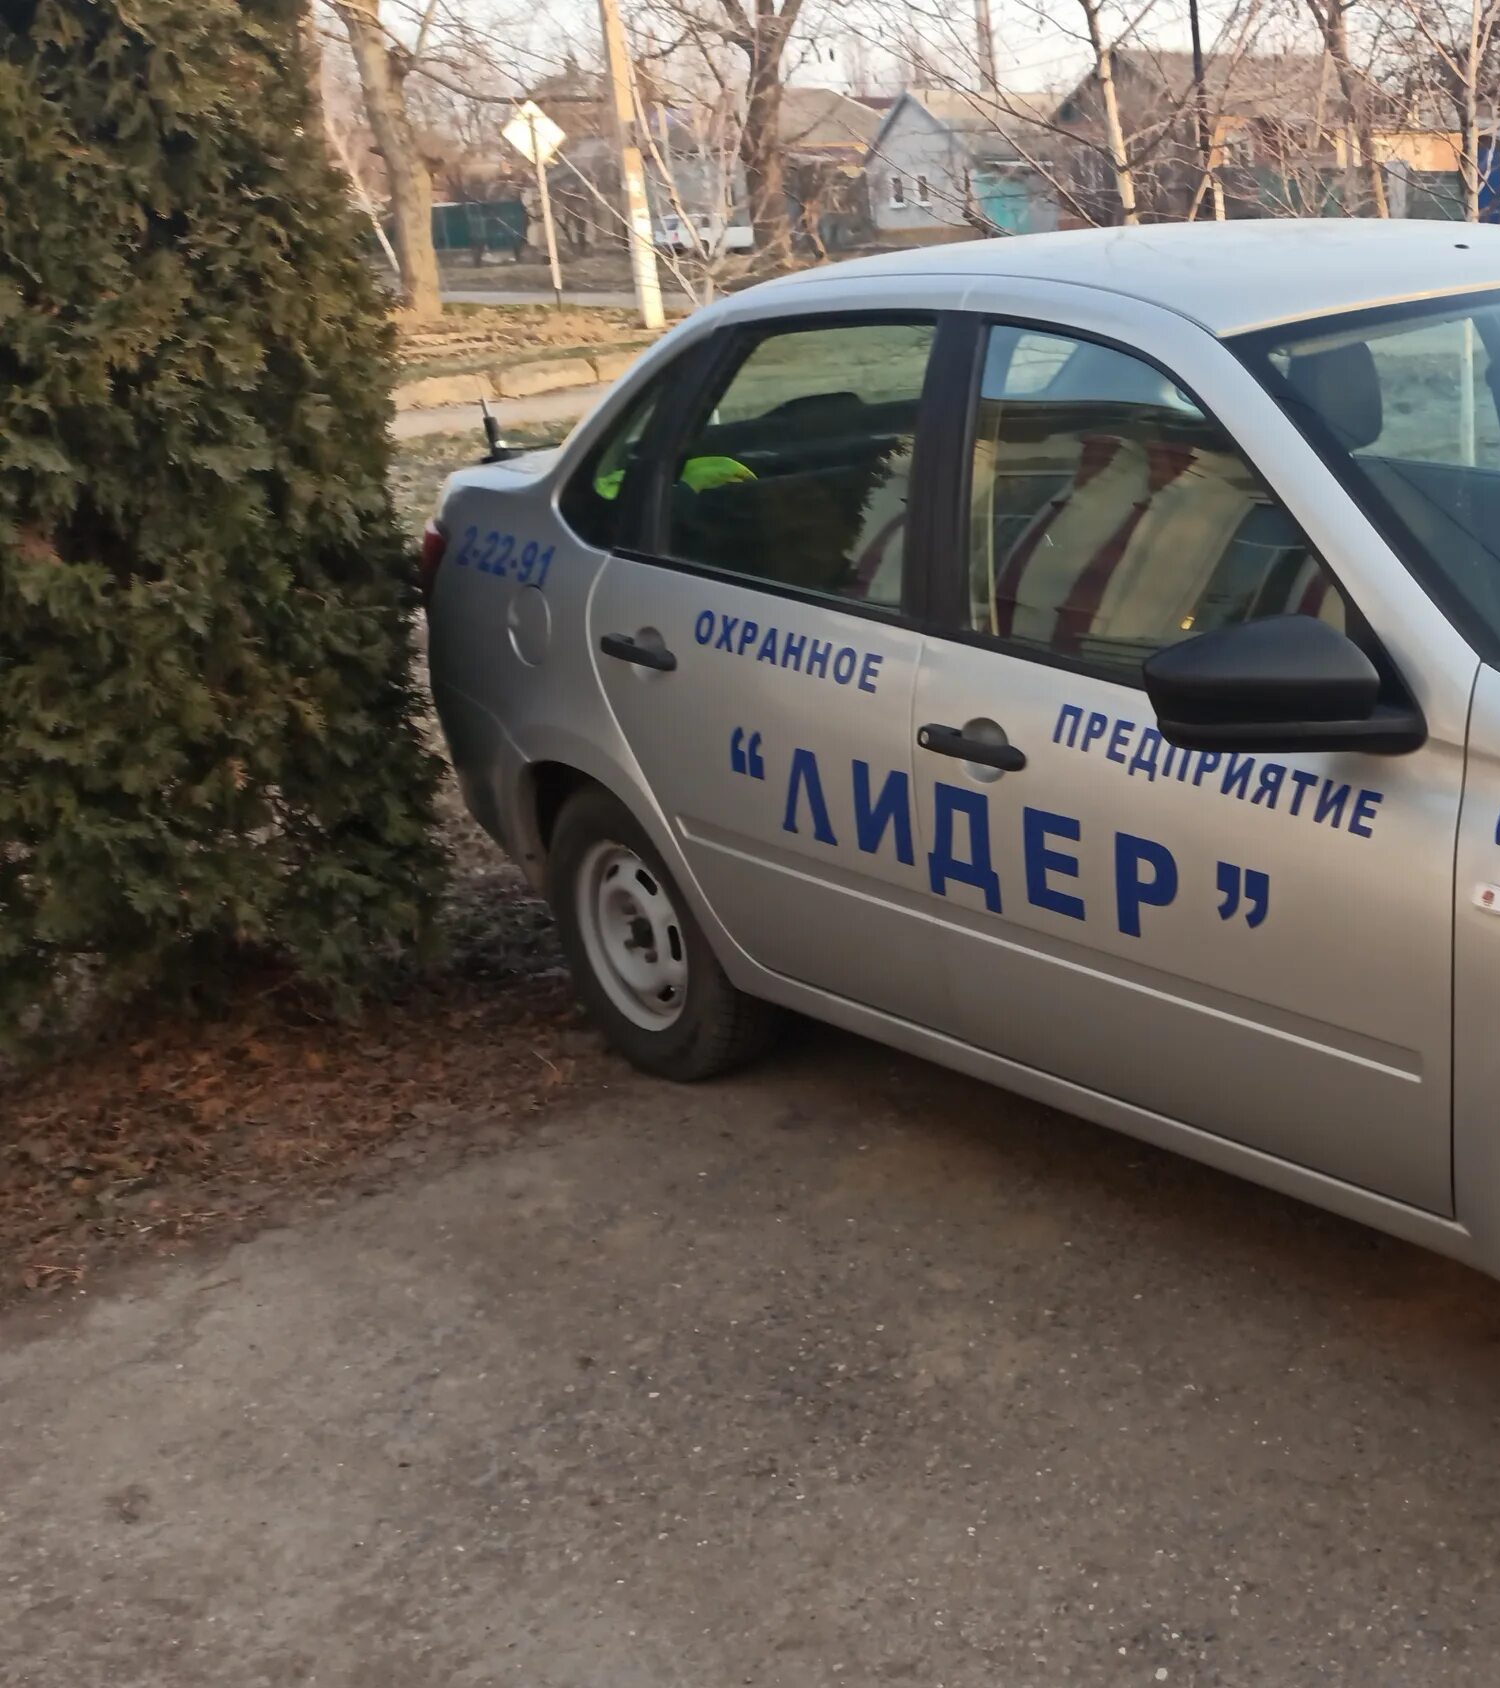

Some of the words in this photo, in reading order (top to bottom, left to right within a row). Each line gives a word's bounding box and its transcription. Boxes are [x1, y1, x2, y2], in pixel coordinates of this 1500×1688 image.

[456, 525, 556, 587] 2-22-91
[694, 609, 884, 694] ОХРАННОЕ
[1052, 703, 1384, 839] ПРЕДПРИЯТИЕ
